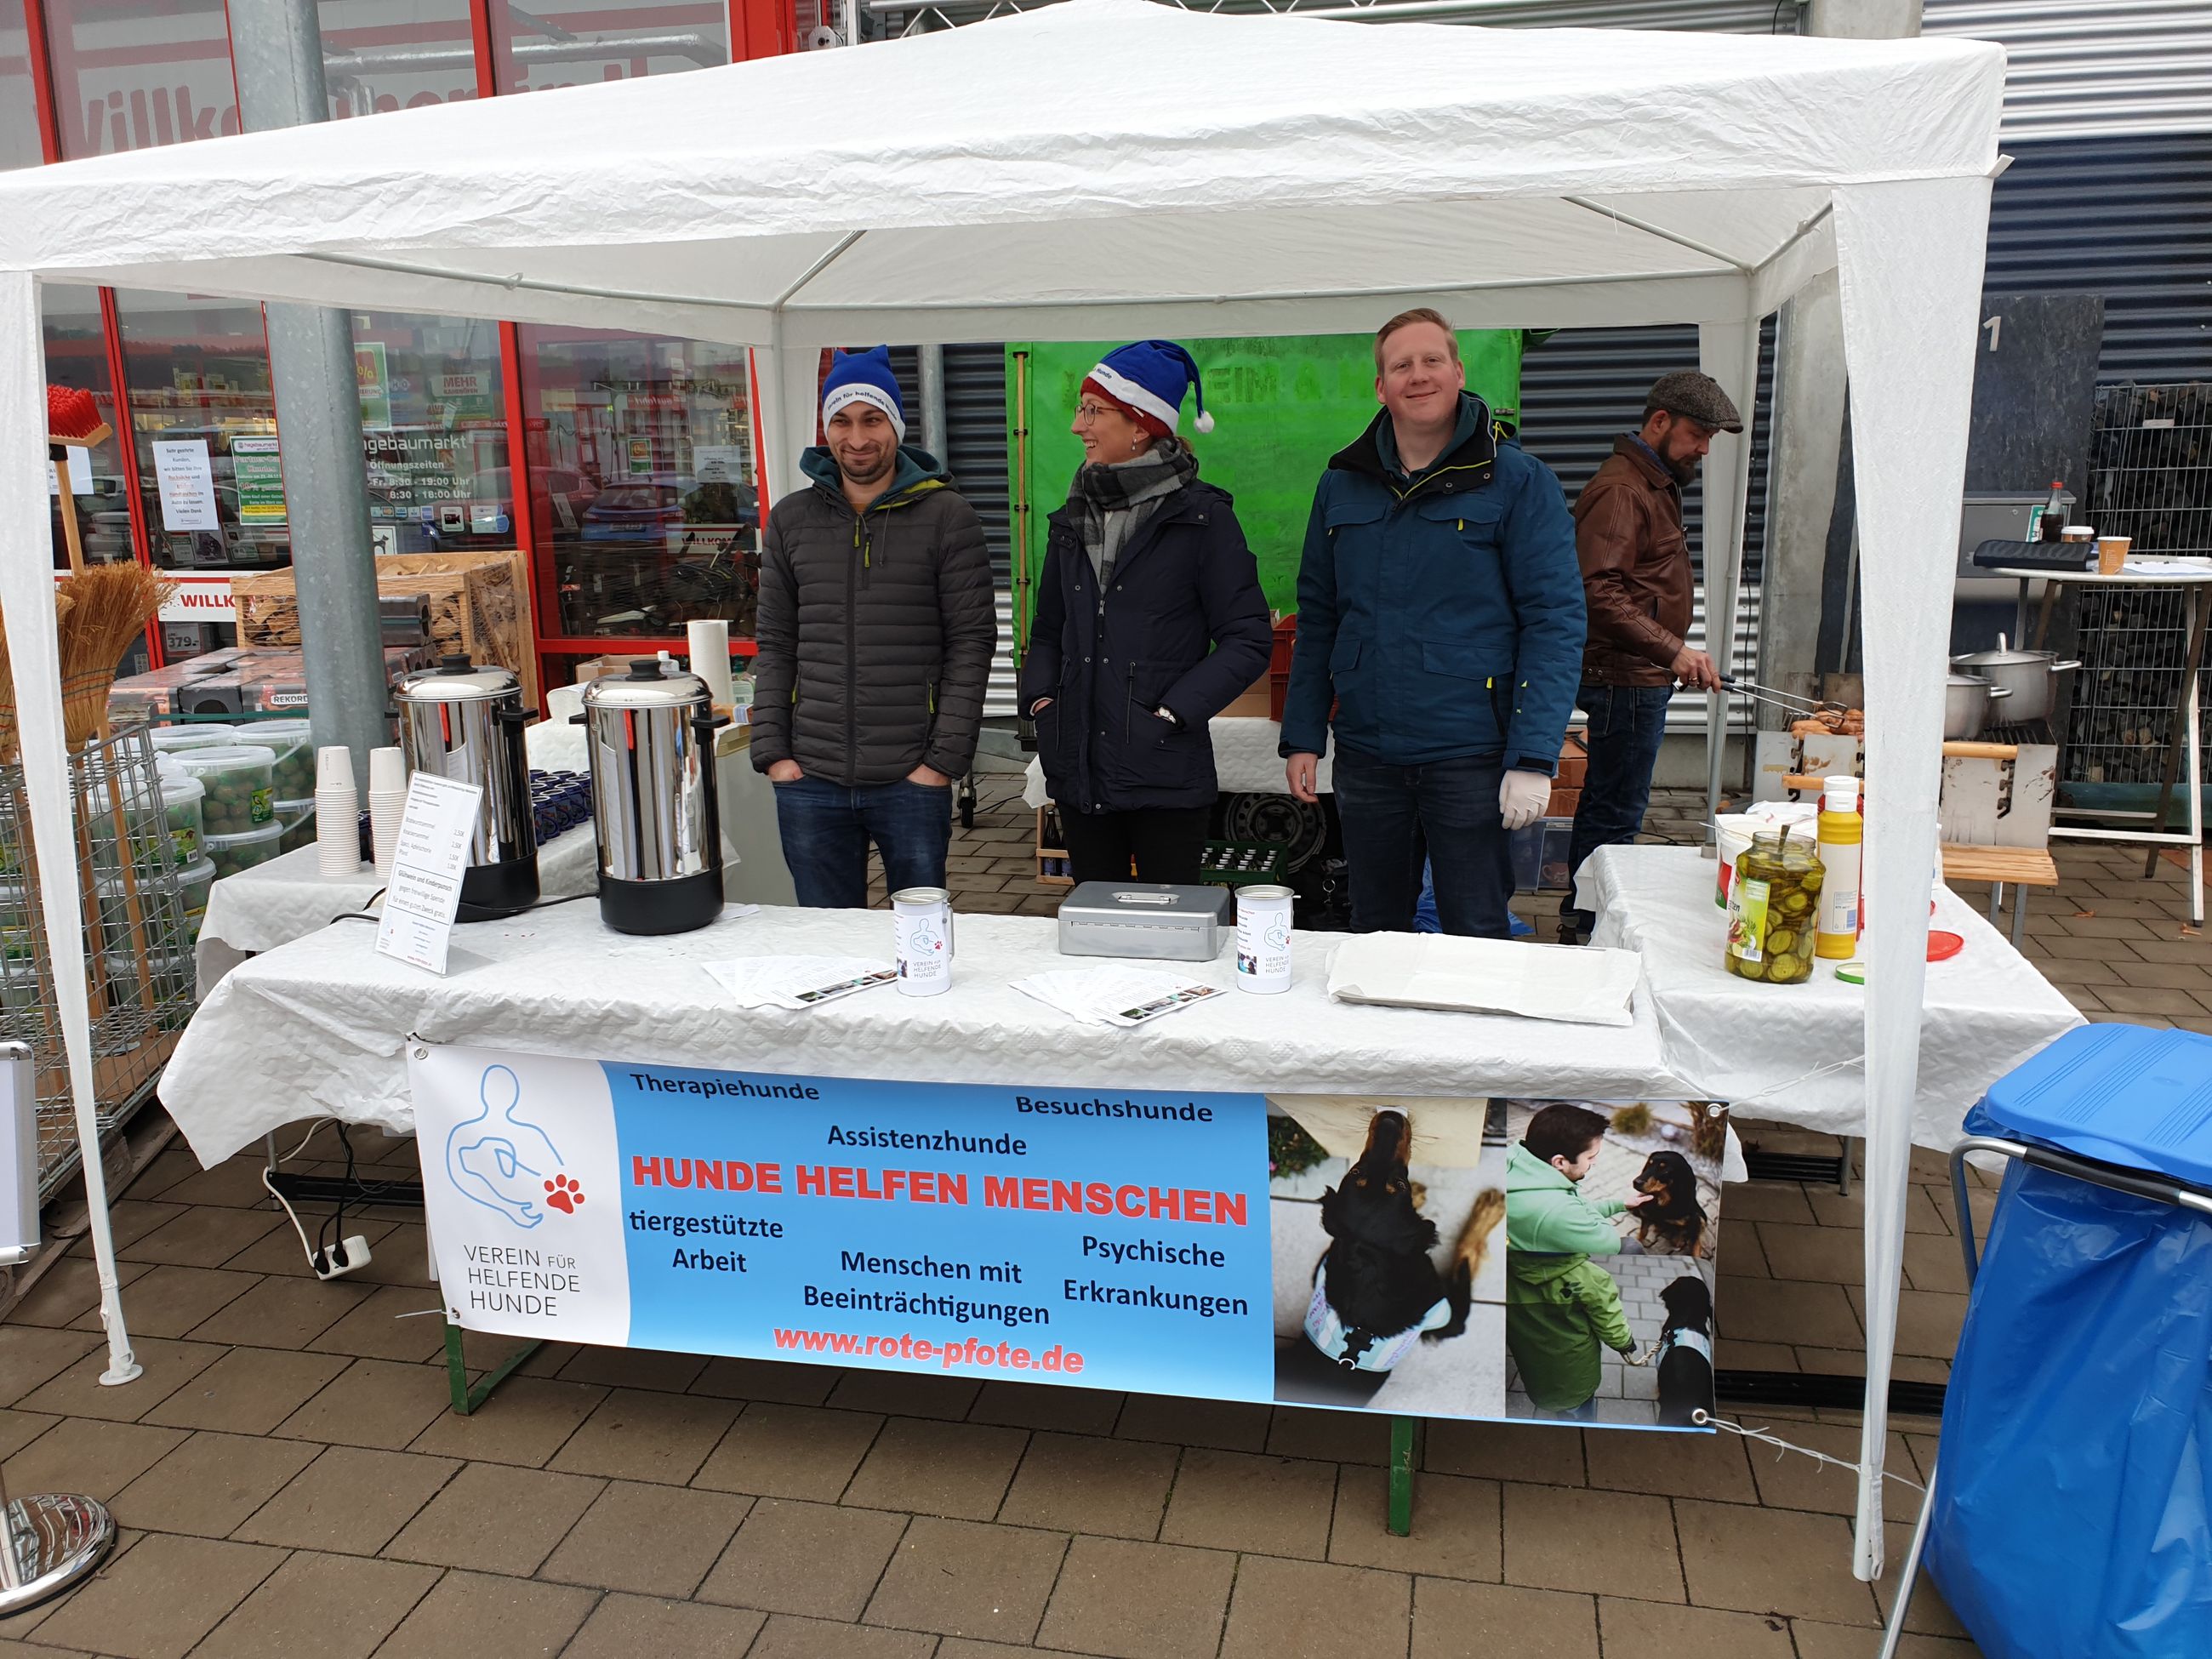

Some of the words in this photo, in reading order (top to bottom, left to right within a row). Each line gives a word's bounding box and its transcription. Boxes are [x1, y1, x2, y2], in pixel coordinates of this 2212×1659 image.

[1983, 316, 2001, 351] 1
[443, 377, 477, 387] MEHR
[369, 459, 445, 471] Öffnungszeiten
[390, 477, 411, 486] 8:30
[421, 476, 449, 486] 19:00
[452, 477, 470, 486] Uhr
[391, 491, 412, 499] 8:30
[453, 491, 471, 499] Uhr
[273, 694, 308, 704] REKORD
[913, 964, 942, 972] HELFENDE
[1265, 960, 1290, 968] HELFENDE
[630, 1073, 820, 1101] Therapiehunde
[1016, 1096, 1213, 1123] Besuchshunde
[827, 1125, 1027, 1155] Assistenzhunde
[632, 1154, 784, 1194] HUNDE
[795, 1164, 968, 1206] HELFEN
[983, 1175, 1248, 1227] MENSCHEN
[630, 1210, 784, 1239] tiergestützte
[464, 1245, 540, 1267] VEREIN
[547, 1254, 576, 1269] FÜR
[672, 1248, 747, 1273] Arbeit
[1082, 1235, 1225, 1268] Psychische
[468, 1267, 580, 1293] HELFENDE
[841, 1251, 971, 1280] Menschen
[979, 1261, 1023, 1284] mit
[470, 1290, 557, 1317] HUNDE
[803, 1285, 1050, 1327] Beeinträchtigungen
[1063, 1279, 1249, 1318] Erkrankungen
[772, 1327, 1086, 1374] www.rote-pfote.de
